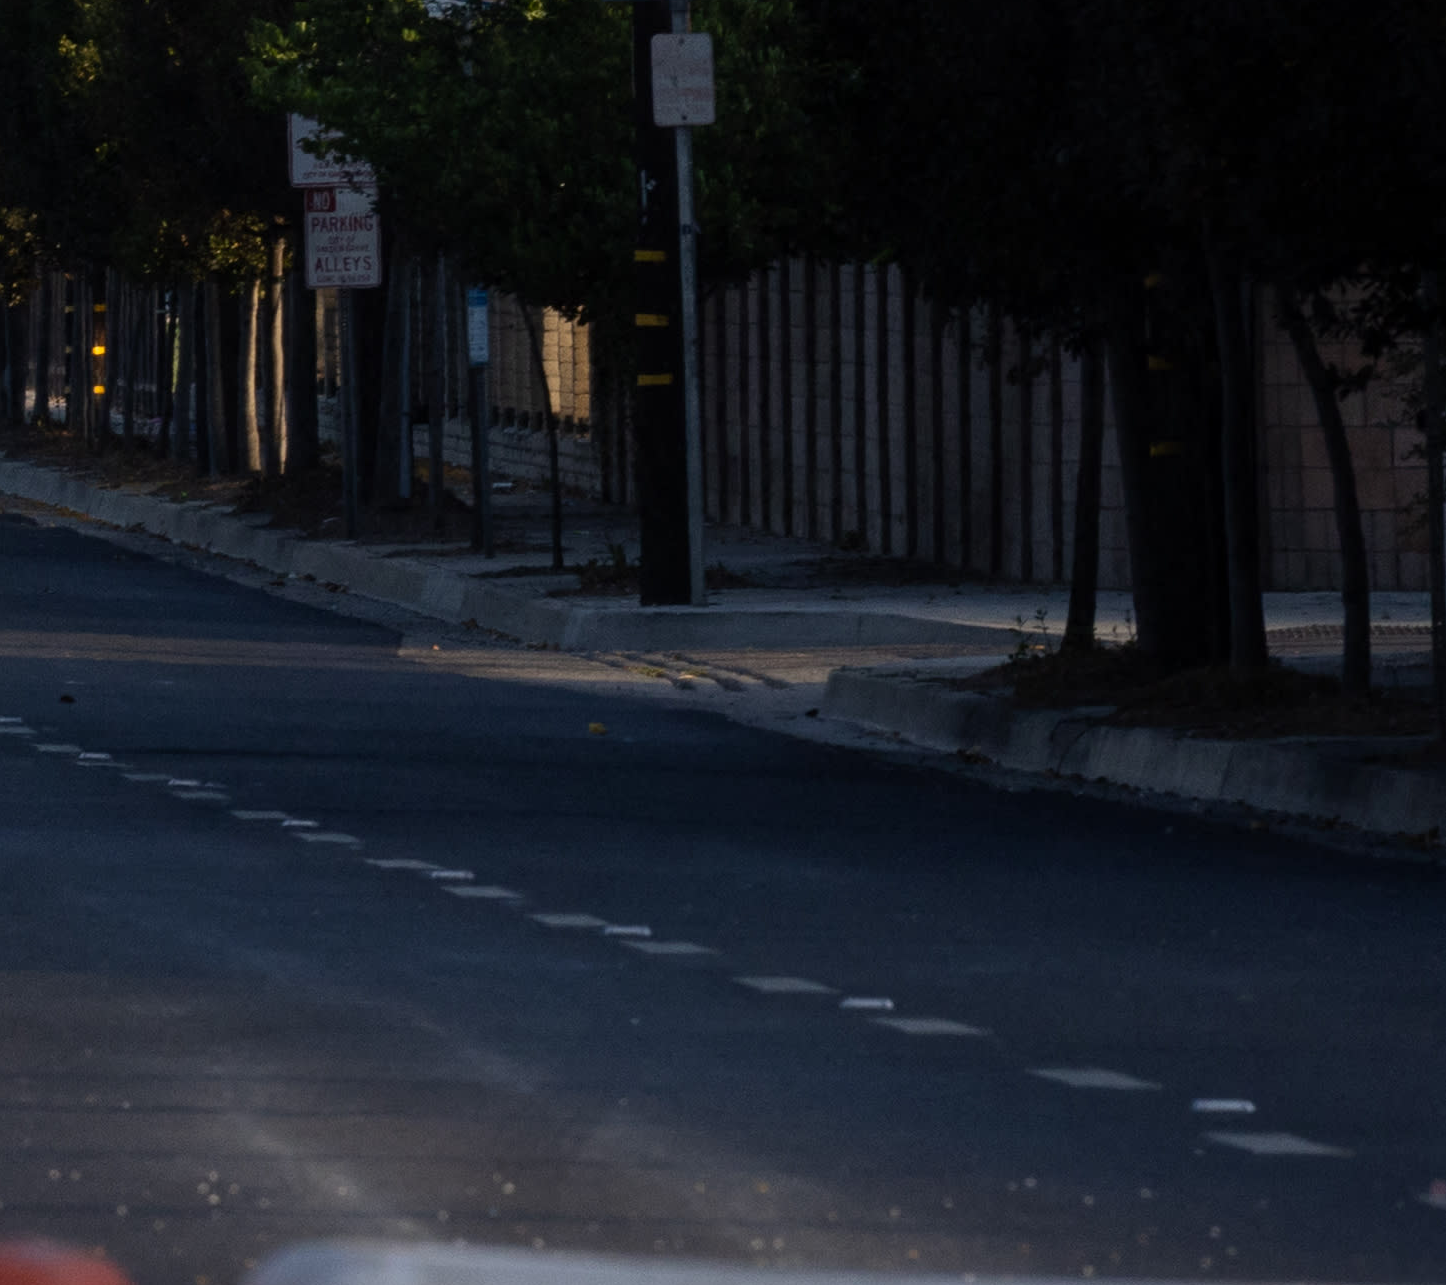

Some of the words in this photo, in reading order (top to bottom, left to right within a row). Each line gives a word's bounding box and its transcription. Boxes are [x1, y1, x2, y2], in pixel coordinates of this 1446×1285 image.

[313, 192, 331, 211] NO
[311, 216, 374, 233] PARKING
[314, 256, 373, 273] ALLEYS
